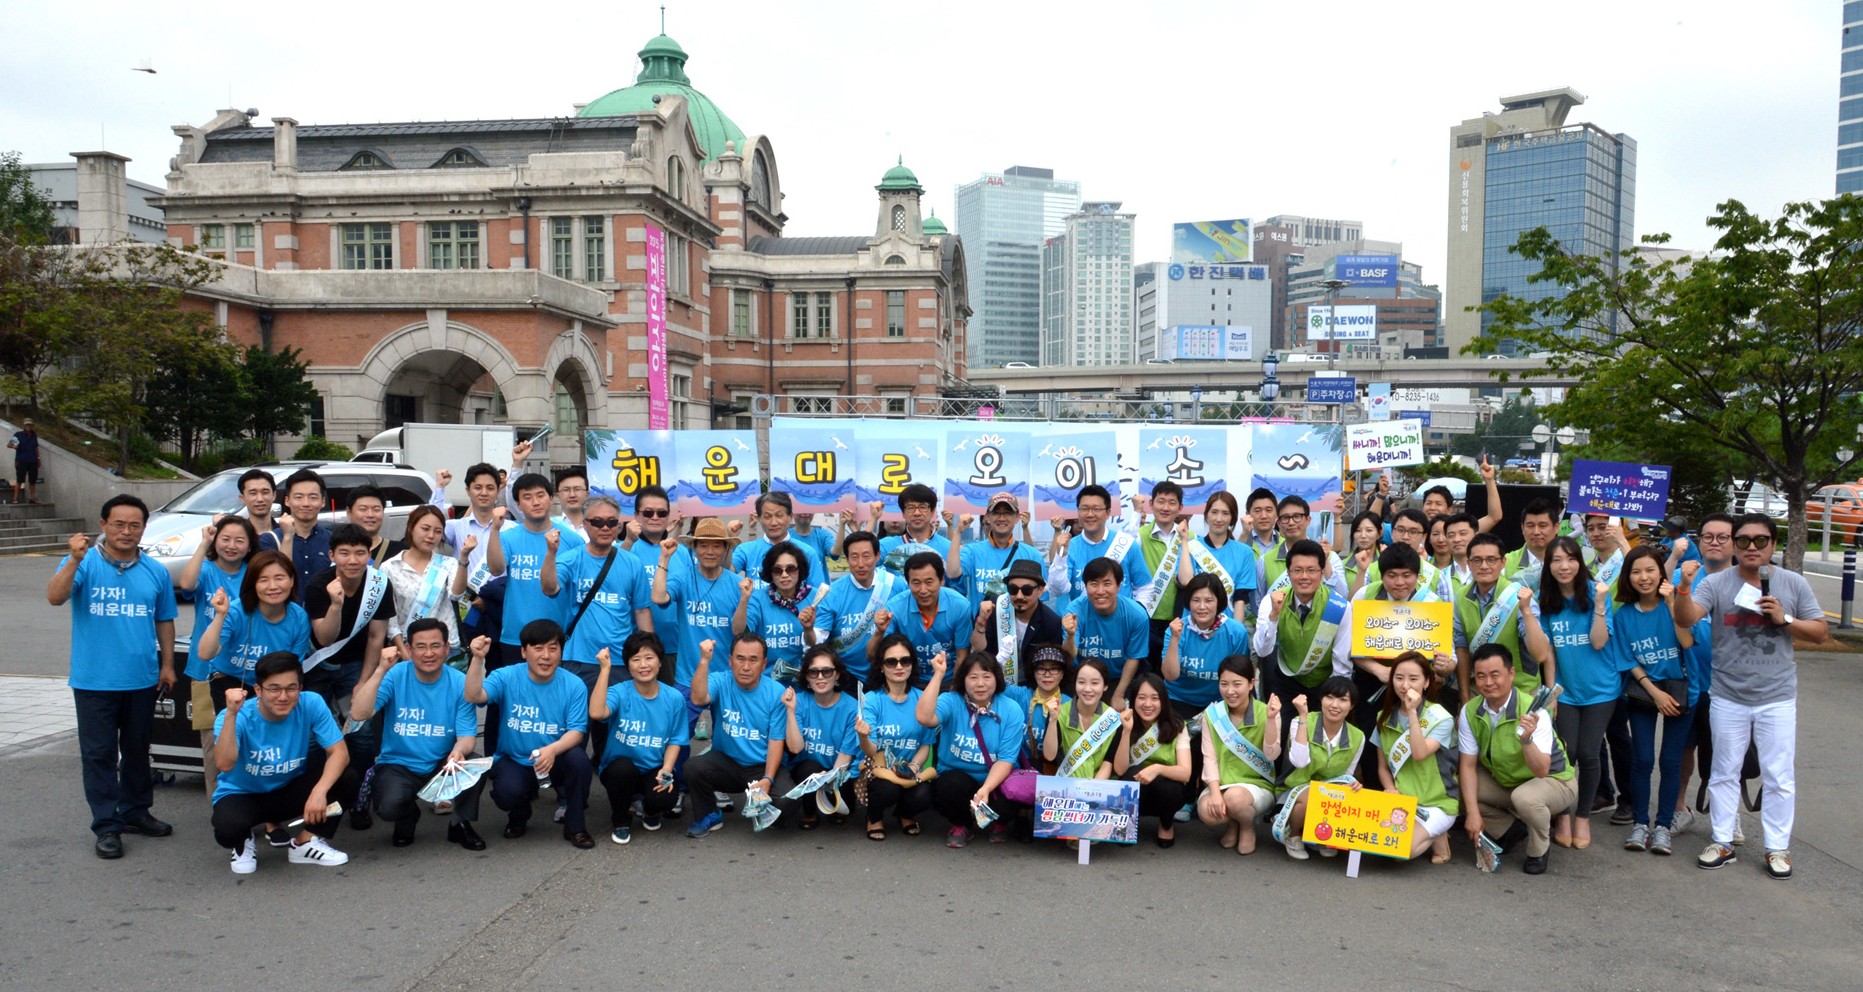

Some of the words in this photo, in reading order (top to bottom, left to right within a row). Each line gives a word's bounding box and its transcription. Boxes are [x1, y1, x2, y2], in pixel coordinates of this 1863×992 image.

[987, 177, 1004, 186] AIA
[1188, 265, 1266, 280] 한진택배
[1360, 268, 1388, 278] BASF
[1325, 316, 1374, 326] DAEWON
[1320, 390, 1344, 400] 주차장
[1384, 433, 1420, 448] 많으니까!
[1589, 500, 1620, 510] 해운대로
[511, 555, 538, 566] 가자!
[91, 586, 126, 600] 가자!
[686, 601, 711, 613] 가자!
[766, 623, 793, 635] 가자!
[1365, 616, 1399, 630] 오이소~
[1404, 617, 1440, 631] 오이소~
[1552, 620, 1569, 632] 자!
[766, 636, 801, 648] 해운대
[1080, 634, 1103, 647] 가자!
[1365, 635, 1403, 651] 해운대로
[1405, 637, 1441, 651] 오이소~
[1553, 634, 1590, 647] 운대로
[1631, 636, 1659, 652] 가자!
[236, 644, 267, 657] 가자!
[1181, 656, 1204, 668] 가자!
[398, 708, 425, 721] 가자!
[512, 703, 539, 718] 가자!
[394, 722, 454, 737] 해운대로~
[507, 717, 565, 735] 해운대로~
[618, 718, 646, 733] 가자!
[878, 724, 900, 736] 가자!
[250, 747, 281, 763] 가자!
[1042, 797, 1090, 811] 해운대에는
[1321, 801, 1361, 818] 망설이지
[1365, 809, 1380, 822] 마!
[1335, 827, 1379, 846] 해운대로
[1384, 836, 1399, 849] 와!
